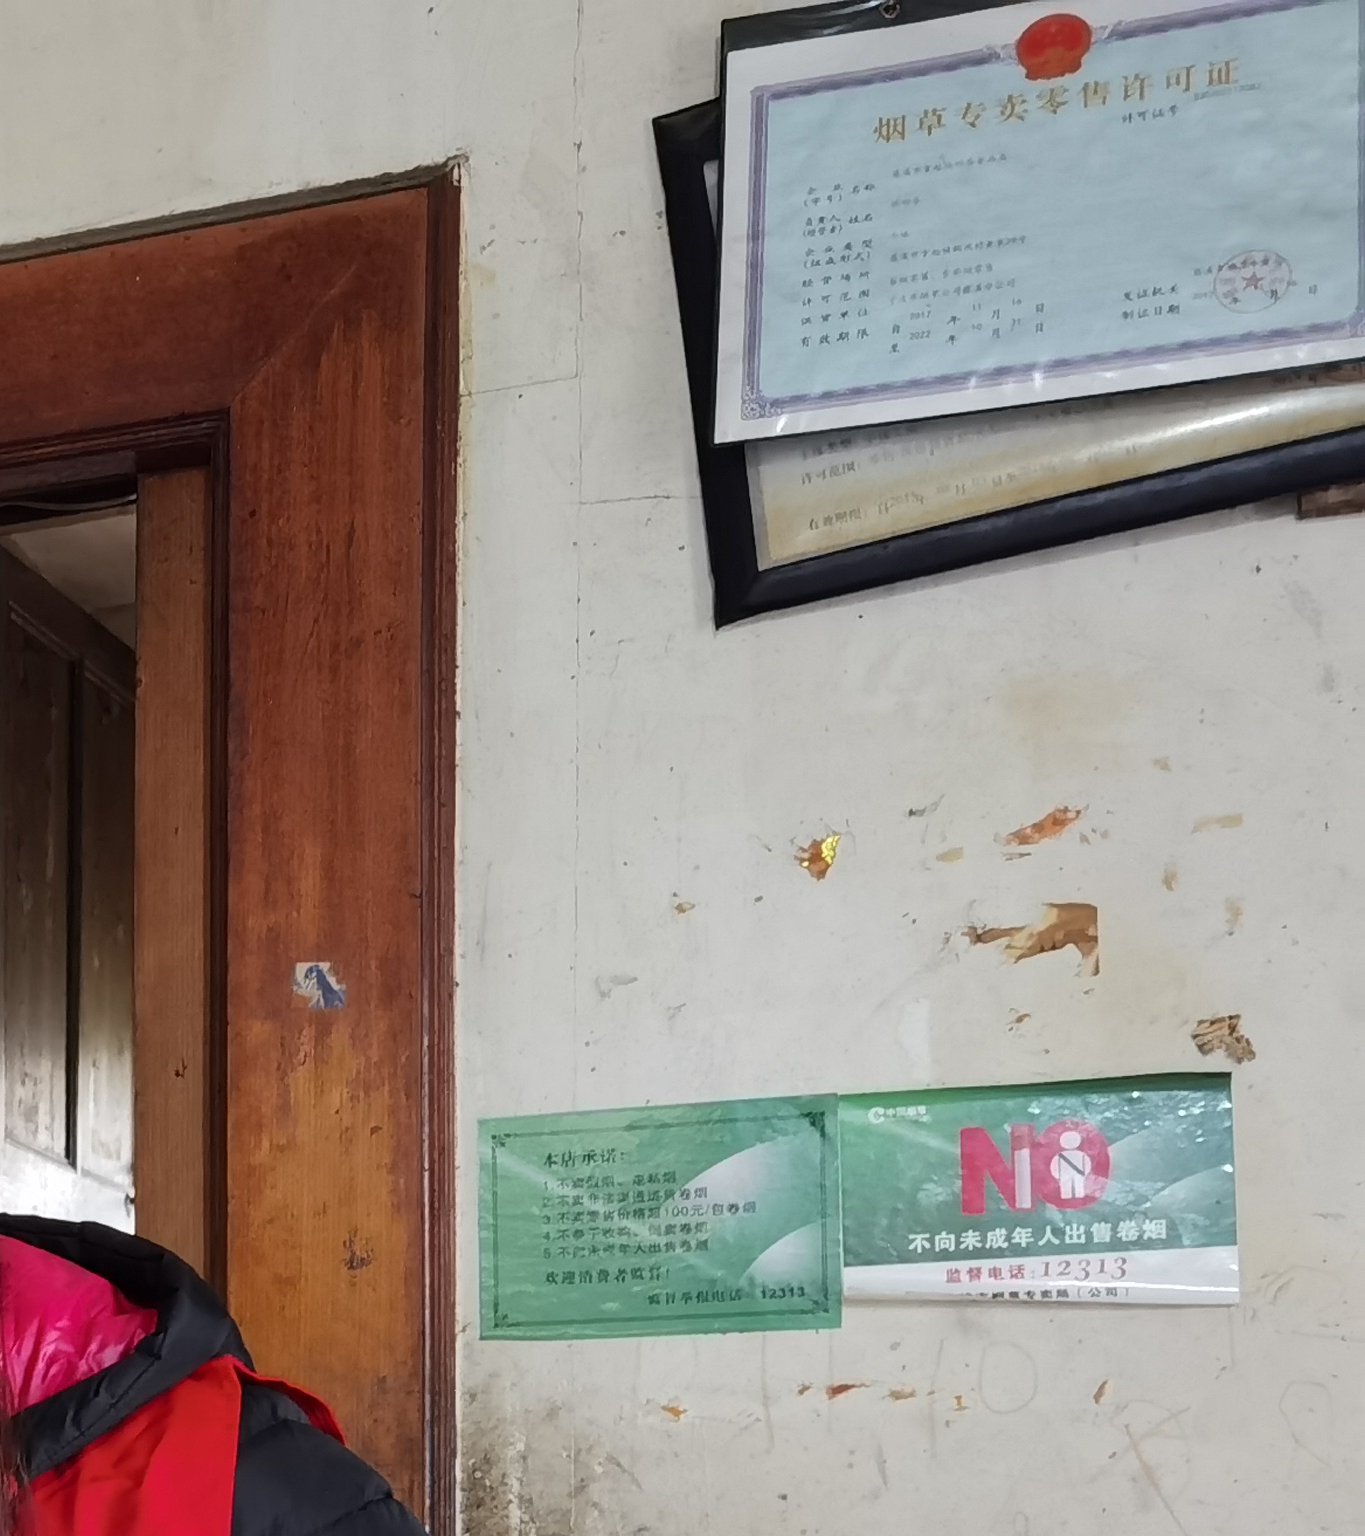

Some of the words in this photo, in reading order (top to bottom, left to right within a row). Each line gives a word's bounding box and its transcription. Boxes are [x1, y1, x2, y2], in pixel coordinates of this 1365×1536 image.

[872, 58, 1239, 143] 烟草专卖零售许可证
[959, 1119, 1111, 1216] NO
[908, 1219, 1168, 1254] 不向未成年人出售卷烟
[760, 1286, 807, 1300] 12313
